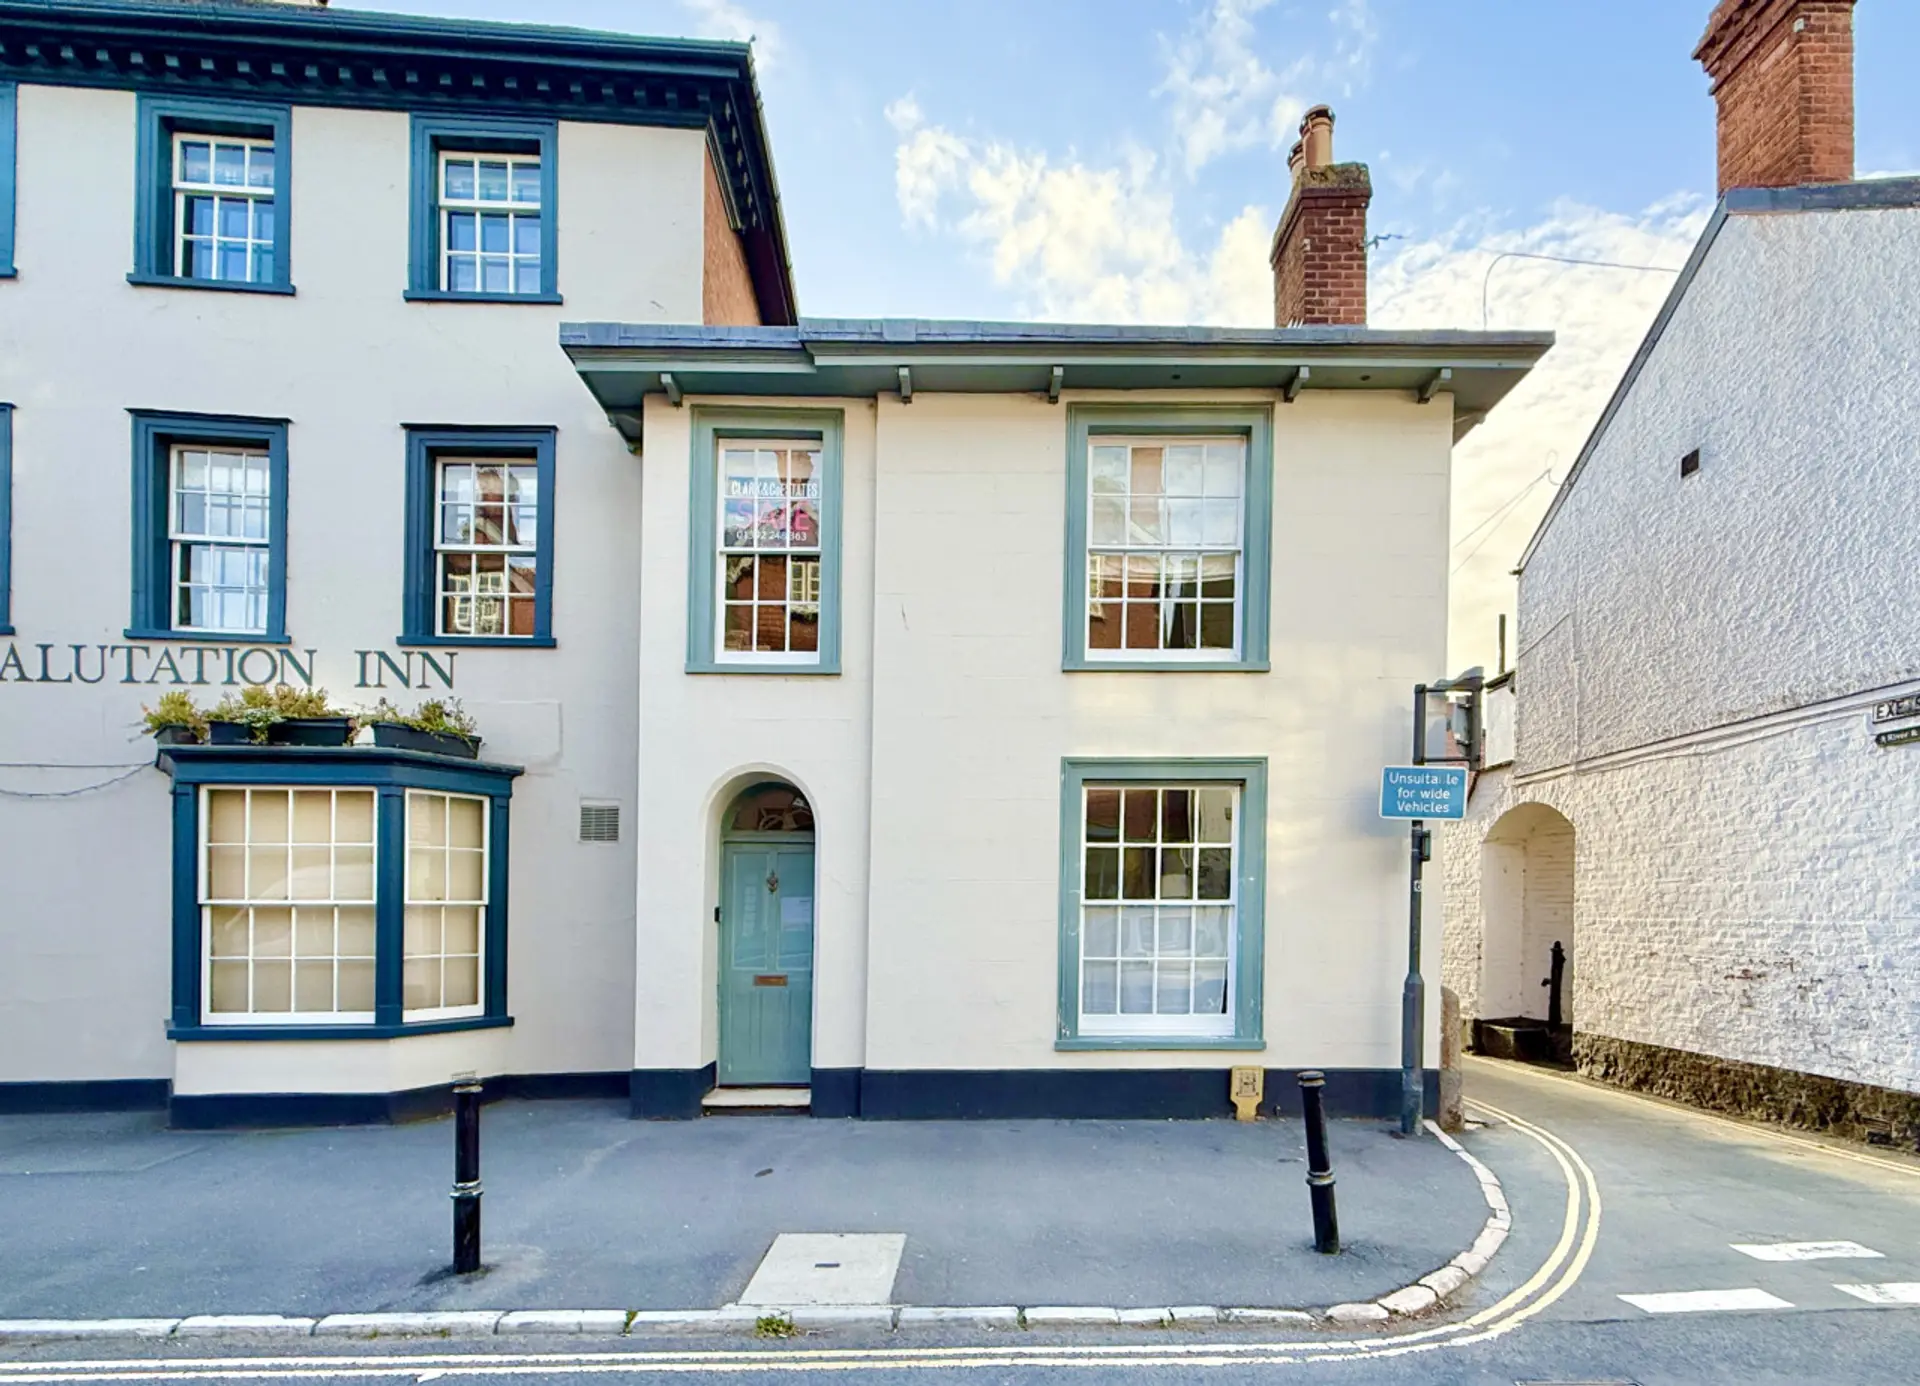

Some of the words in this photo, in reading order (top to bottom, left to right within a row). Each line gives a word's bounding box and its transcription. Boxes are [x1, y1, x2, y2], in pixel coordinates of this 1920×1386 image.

[0, 642, 318, 687] ALUTATION
[354, 649, 459, 690] INN
[1388, 771, 1460, 786] Unsuitale
[1397, 787, 1416, 799] for
[1420, 787, 1451, 800] wide
[1396, 800, 1450, 813] Vehicles
